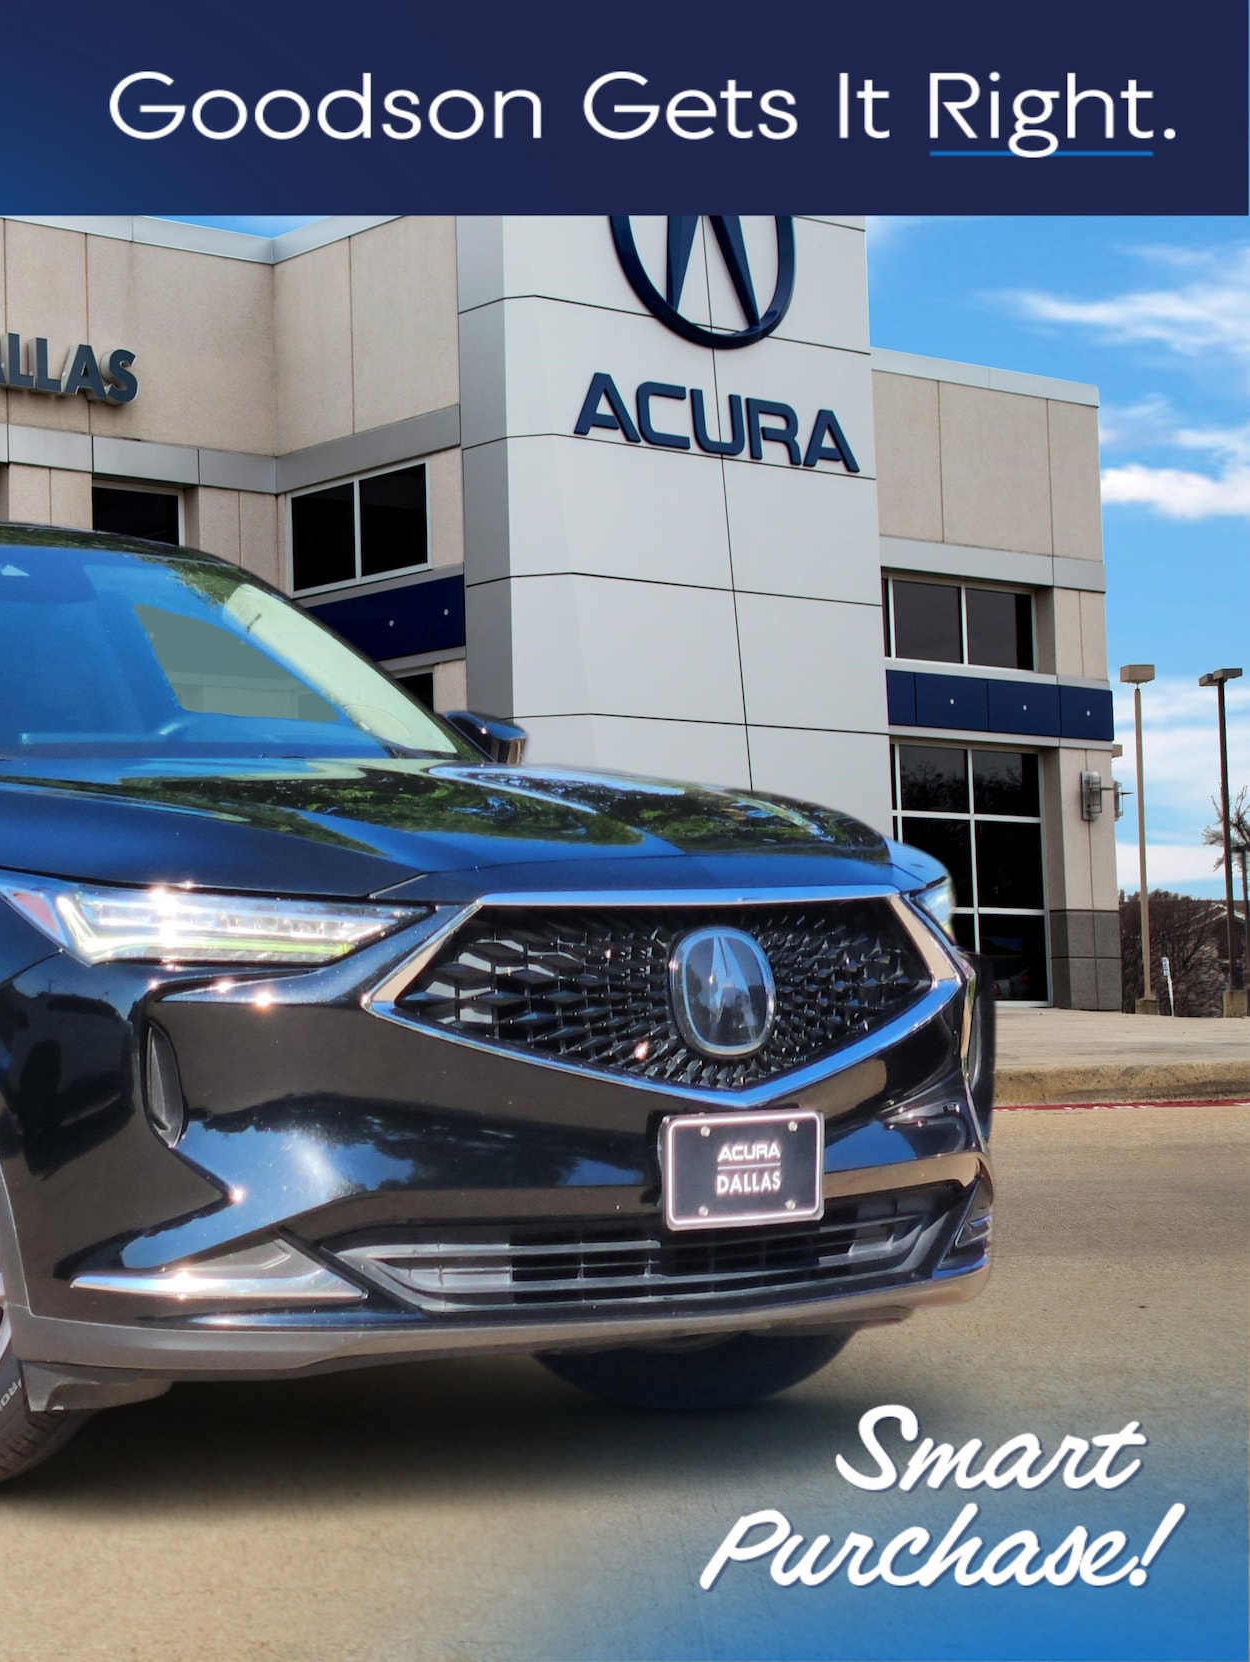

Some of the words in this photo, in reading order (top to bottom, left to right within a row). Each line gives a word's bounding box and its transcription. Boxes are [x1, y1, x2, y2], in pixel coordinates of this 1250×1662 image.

[573, 372, 860, 473] ACURA
[717, 1142, 781, 1162] ACURA
[716, 1171, 782, 1195] DALLAS
